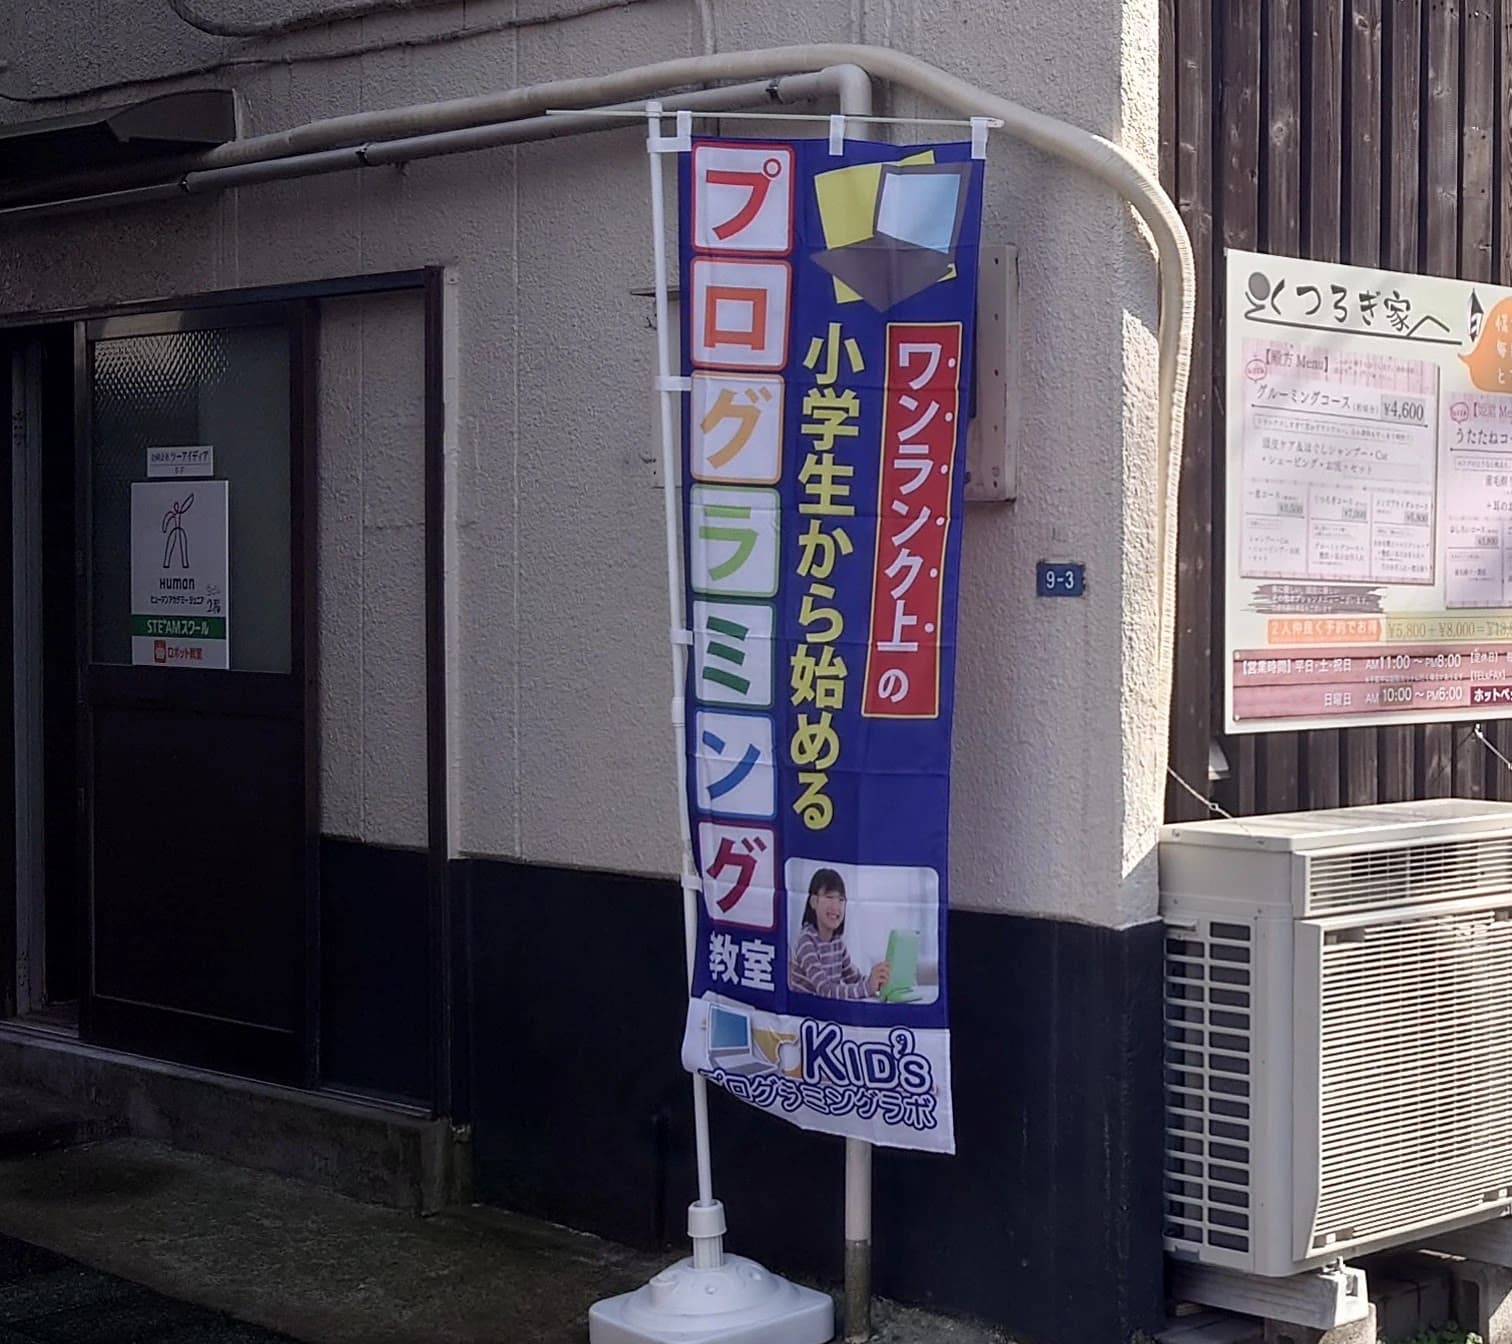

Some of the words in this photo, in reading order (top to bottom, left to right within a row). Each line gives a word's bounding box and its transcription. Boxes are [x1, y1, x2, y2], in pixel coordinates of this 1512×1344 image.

[1383, 399, 1425, 421] ¥4,600
[699, 157, 783, 914] プログラミング
[876, 341, 942, 703] ワンランク上の
[789, 322, 865, 831] 小学生から始める
[1044, 570, 1076, 591] 9-3
[1324, 693, 1352, 706] 日曜日
[708, 932, 776, 992] 教室
